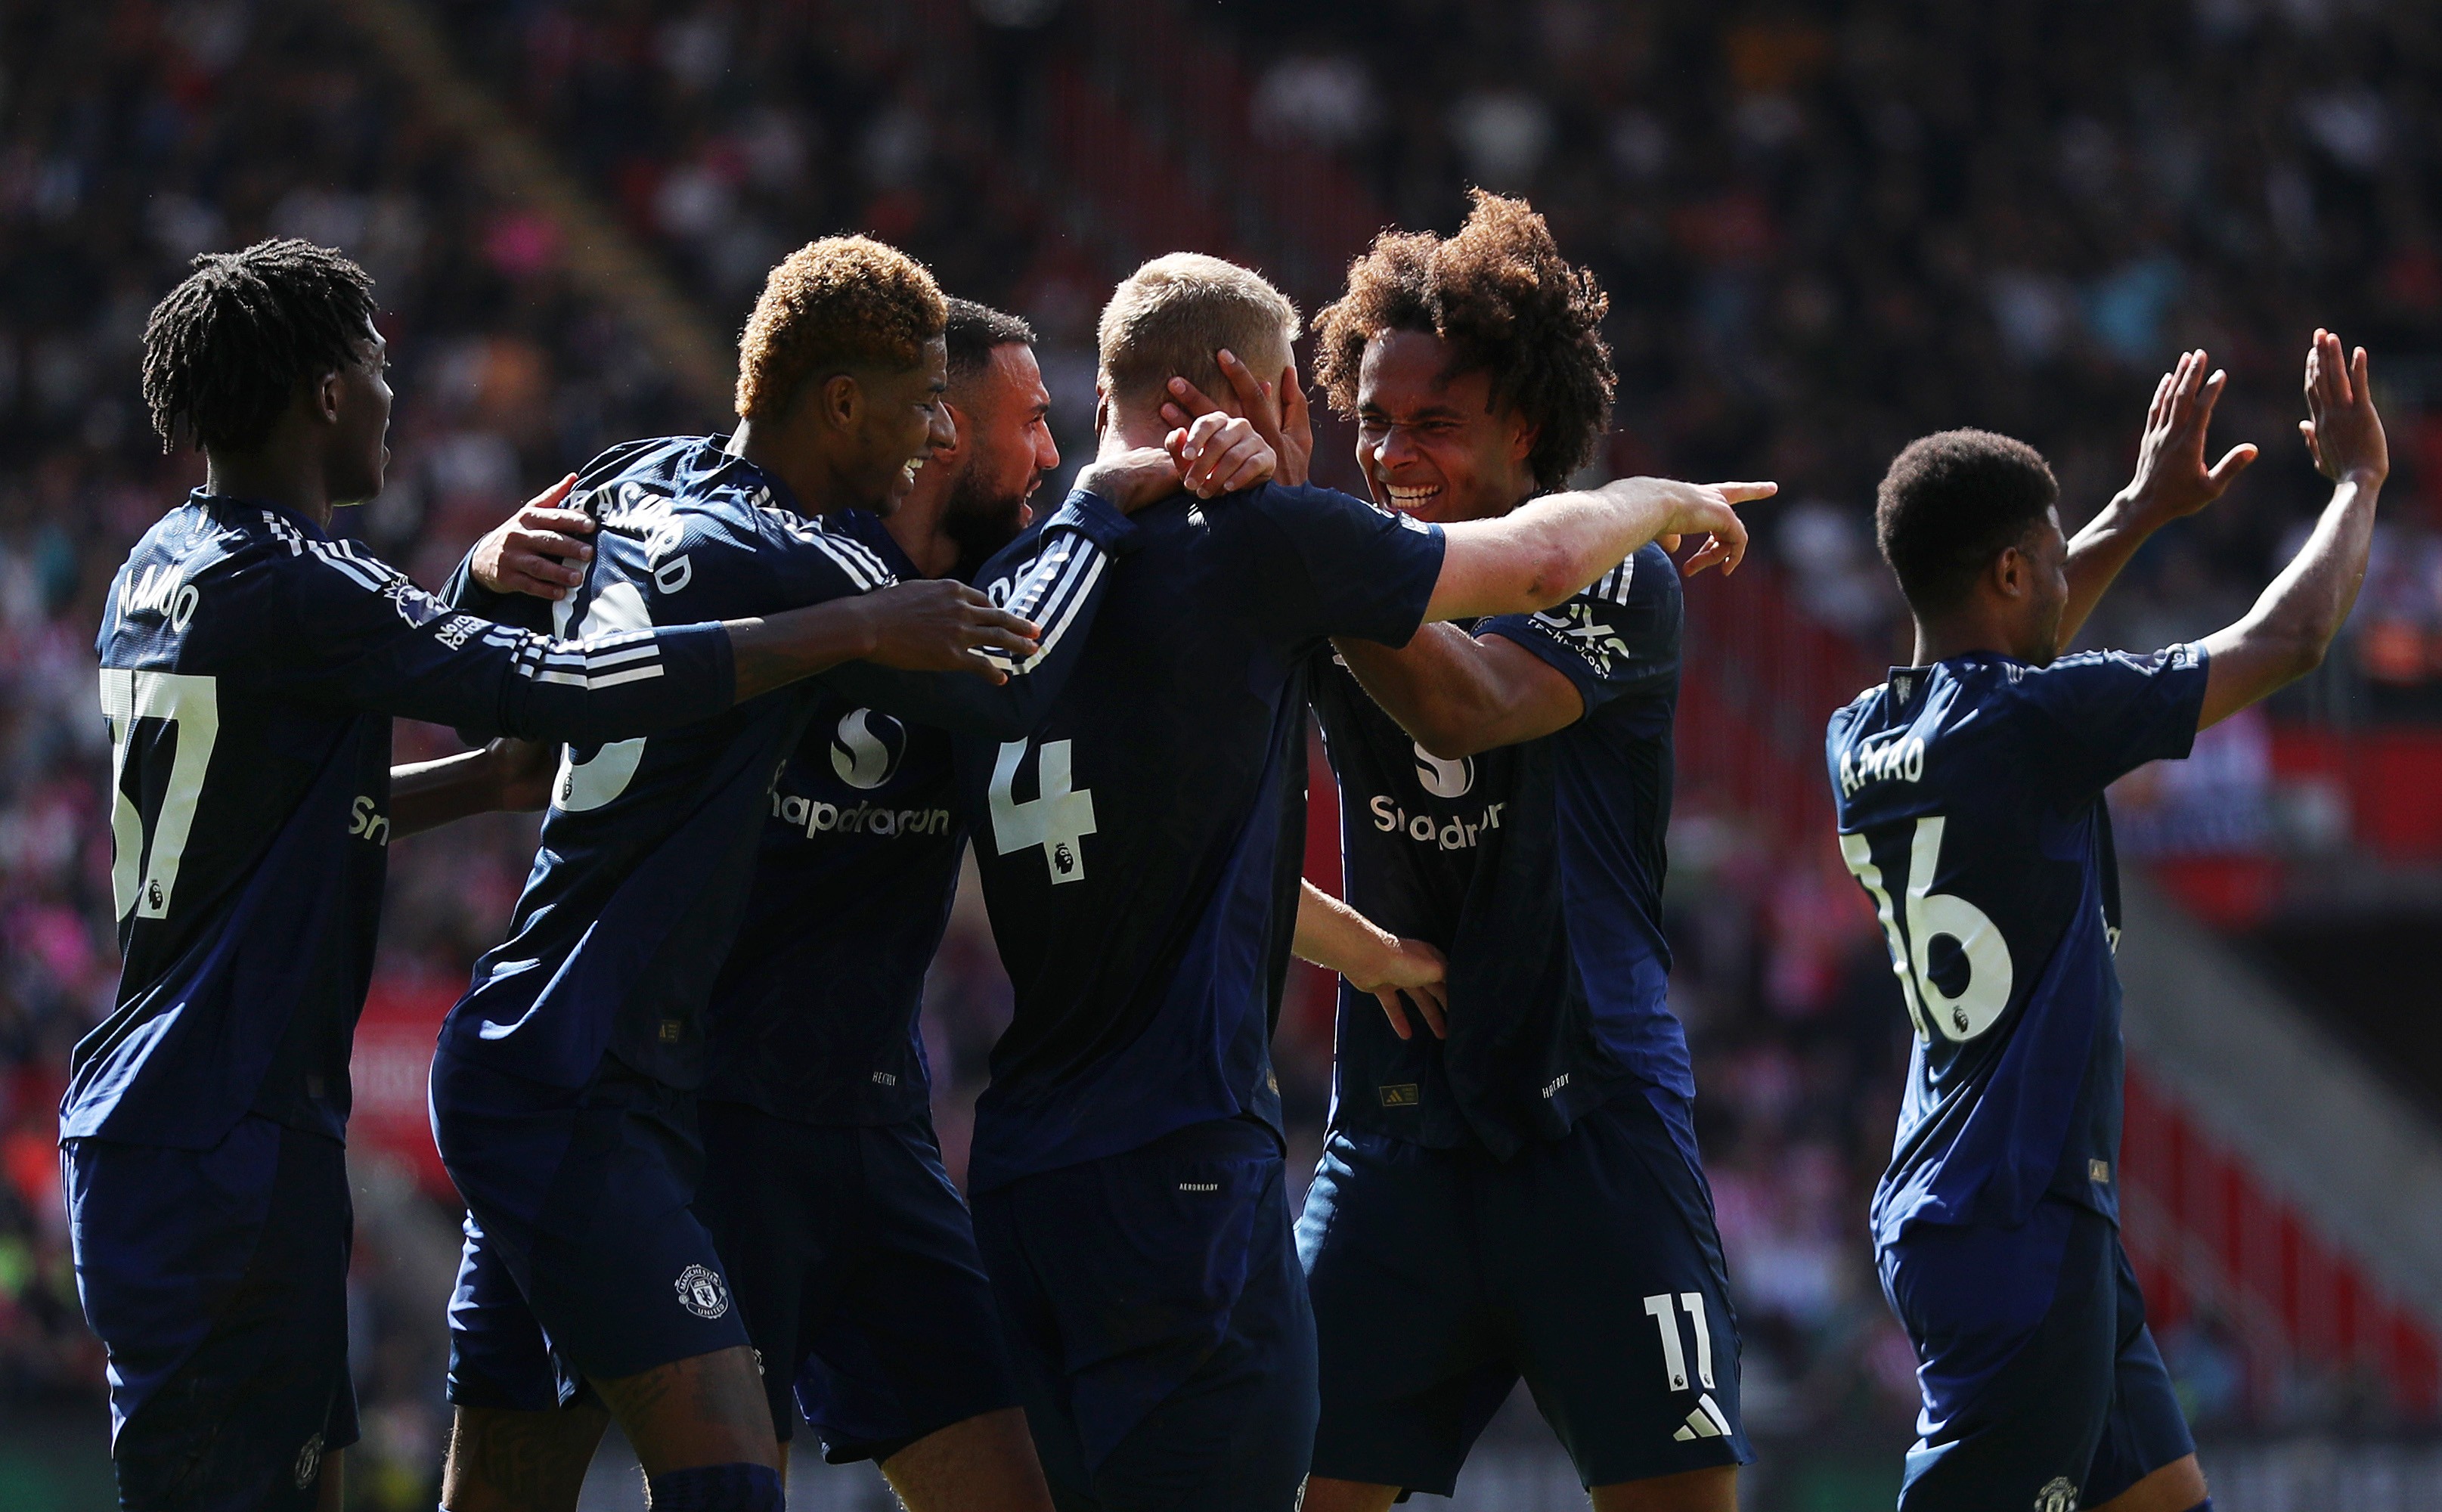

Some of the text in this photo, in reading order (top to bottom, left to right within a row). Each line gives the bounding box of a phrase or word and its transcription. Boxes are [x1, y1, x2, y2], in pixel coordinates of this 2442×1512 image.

[988, 736, 1097, 885] 4
[1839, 816, 2013, 1043] 16
[1179, 1183, 1218, 1191] AEROREADY
[697, 1303, 725, 1315] UNITED
[1644, 1292, 1715, 1391] 11
